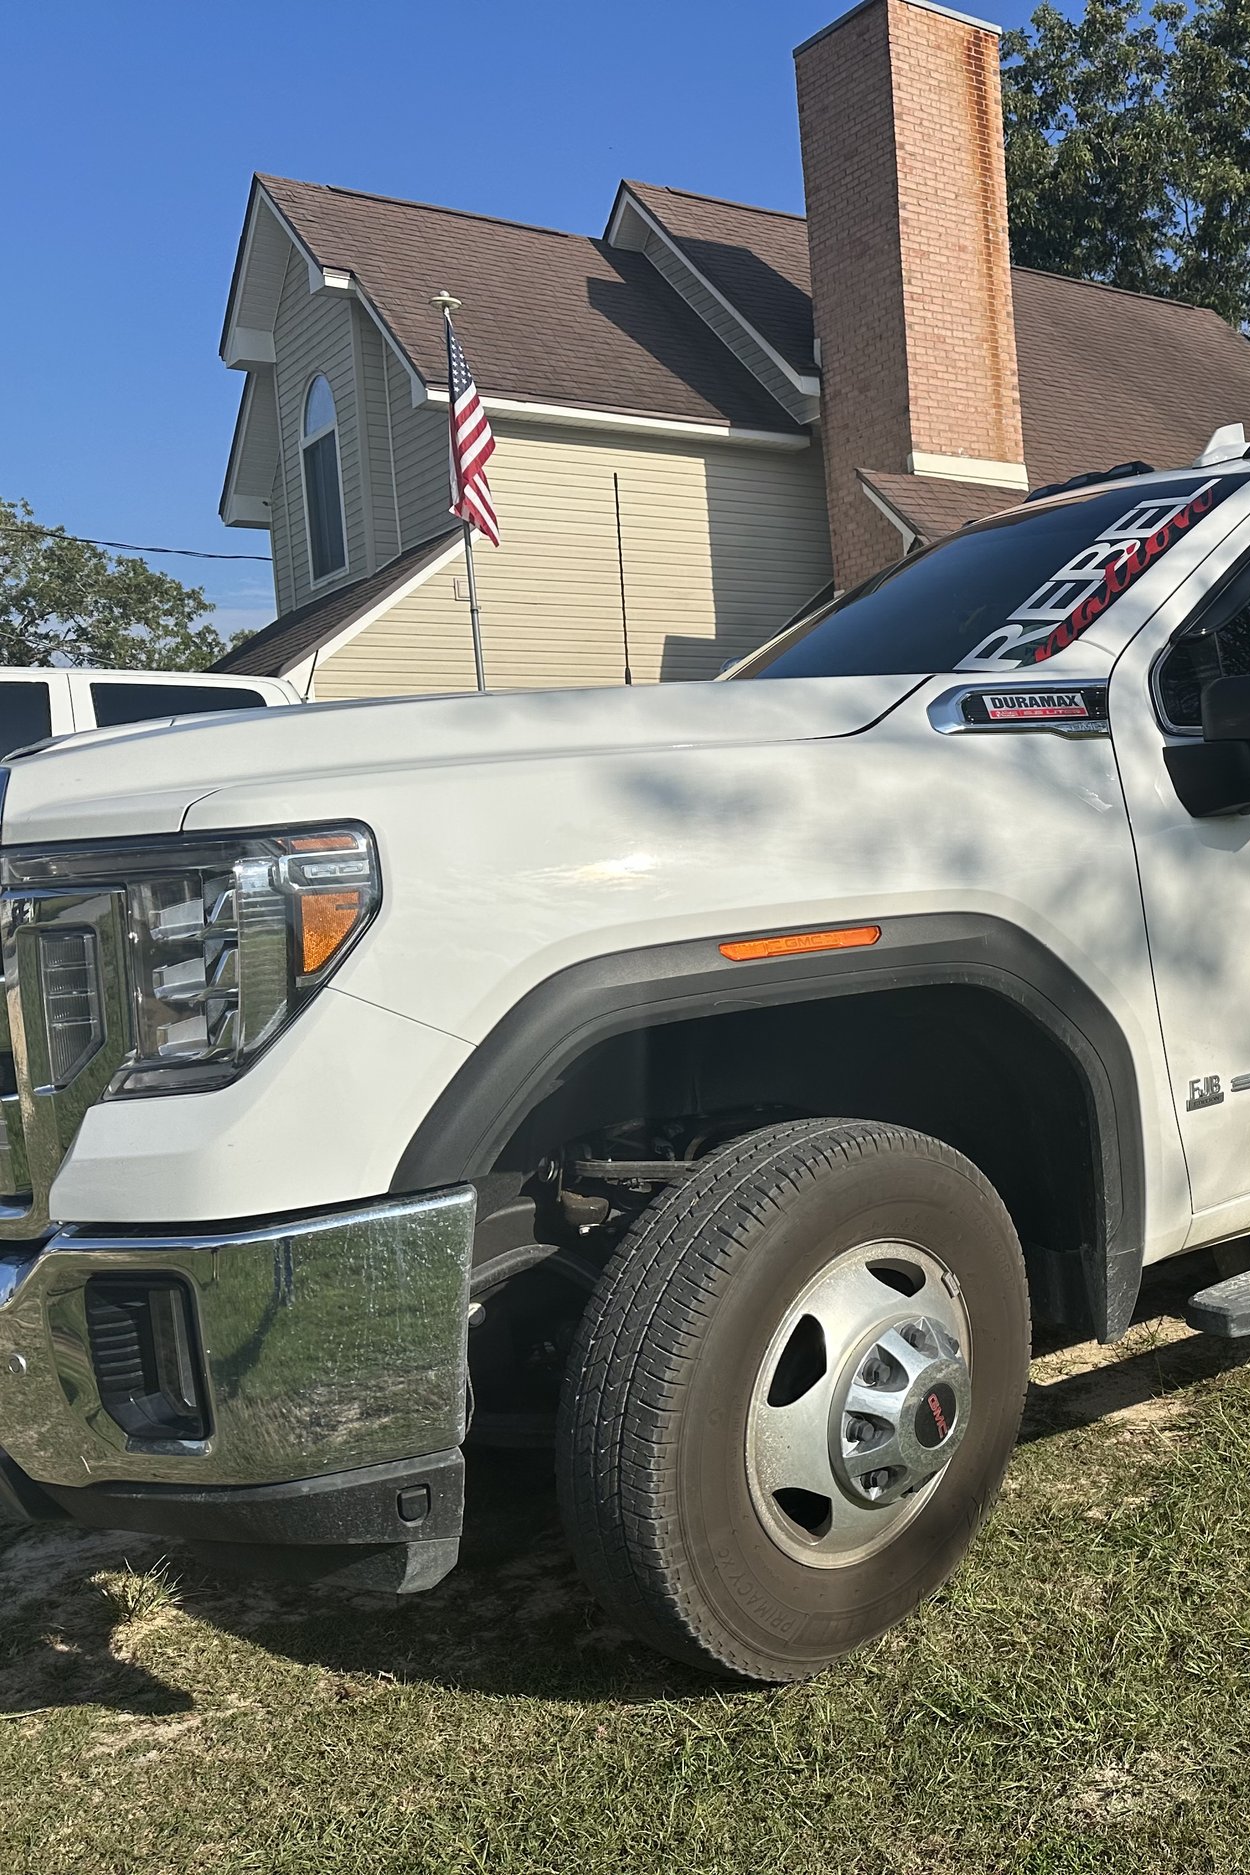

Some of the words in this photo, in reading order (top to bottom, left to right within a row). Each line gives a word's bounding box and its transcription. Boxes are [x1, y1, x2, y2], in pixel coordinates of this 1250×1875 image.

[953, 478, 1222, 672] REBEL
[990, 695, 1080, 708] DURAMAX
[784, 936, 823, 950] GMC
[1189, 1075, 1221, 1100] FJB
[927, 1393, 948, 1439] GMC
[729, 1573, 798, 1633] PRIMACY
